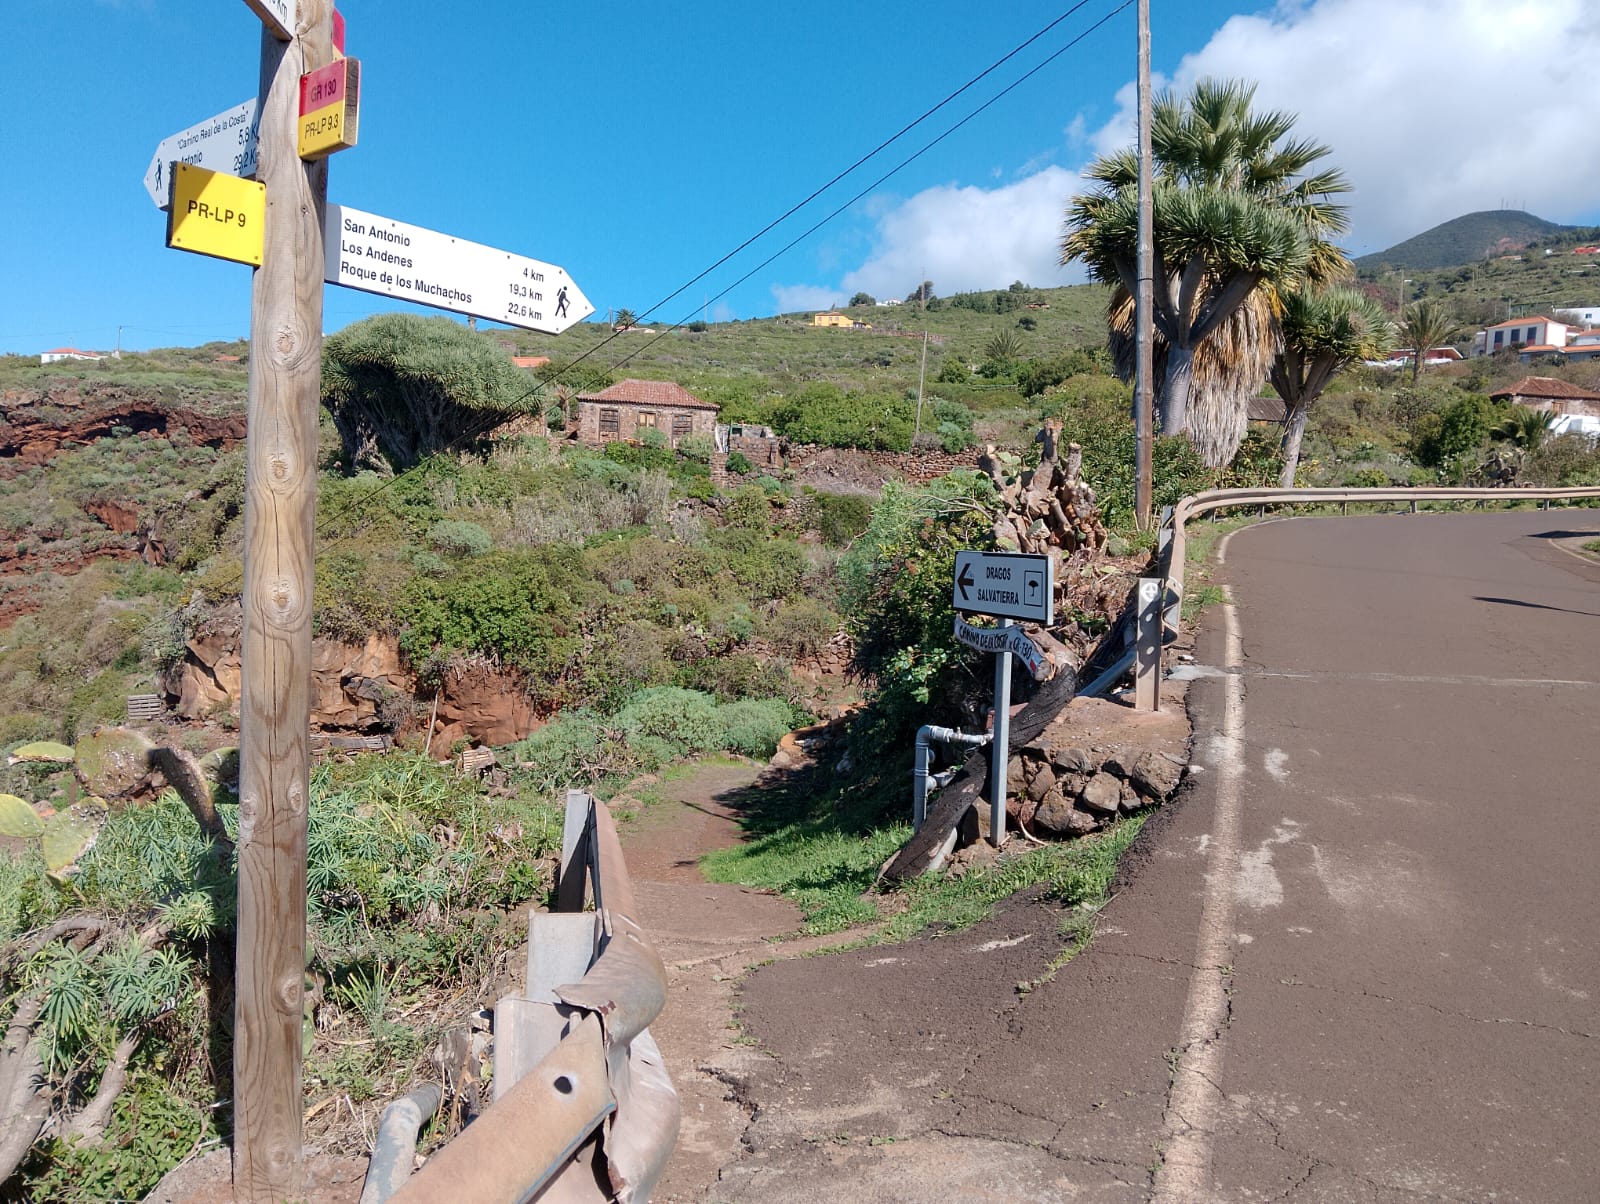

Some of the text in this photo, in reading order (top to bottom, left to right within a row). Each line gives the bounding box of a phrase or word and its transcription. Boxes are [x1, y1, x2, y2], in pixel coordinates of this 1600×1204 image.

[311, 78, 337, 102] GR 130
[200, 126, 213, 140] Real
[213, 122, 221, 135] de
[222, 119, 228, 130] la
[238, 126, 250, 146] 5,8
[304, 113, 339, 139] PR-LP 9.3
[187, 200, 246, 228] PR-LP 9
[344, 218, 545, 283] San Antonio 4 km
[342, 239, 543, 302] Los Andenes 19,3 km
[341, 260, 542, 321] Roque de los Muchachos 22,6 km
[986, 566, 1011, 581] DRAGOS
[977, 588, 1020, 605] SALVATIERRA
